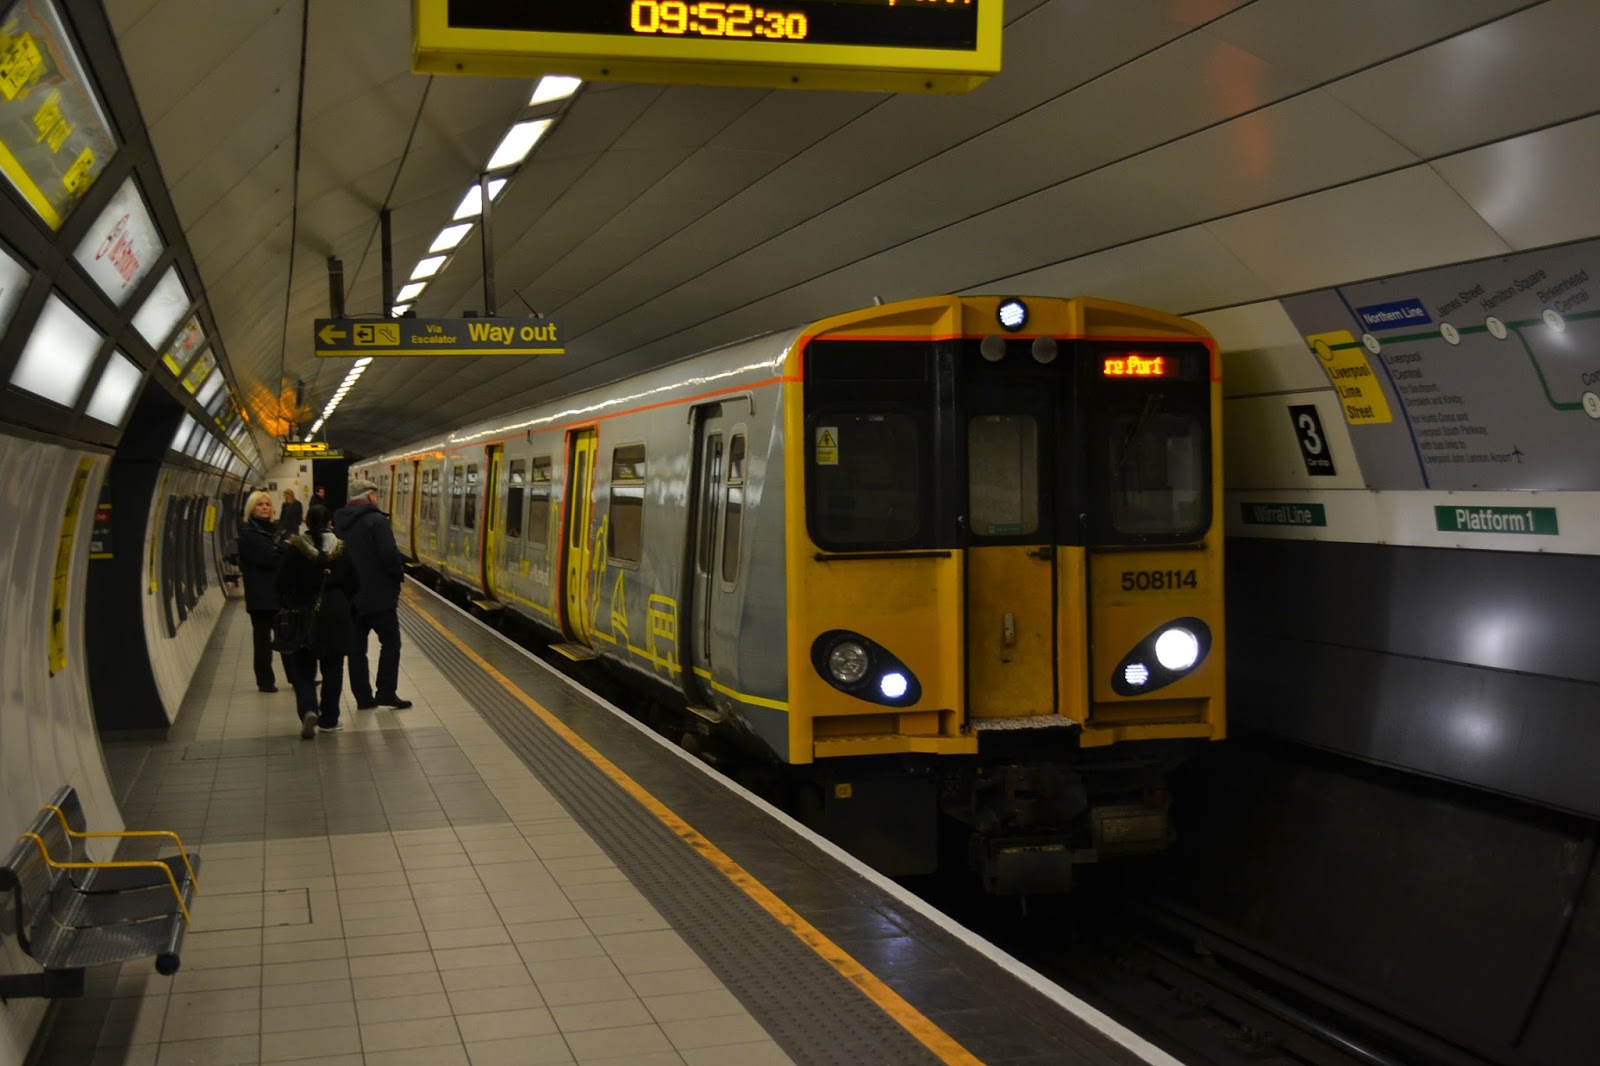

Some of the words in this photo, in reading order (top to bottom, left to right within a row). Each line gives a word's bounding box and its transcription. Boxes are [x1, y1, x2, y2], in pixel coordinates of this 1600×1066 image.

[631, 0, 807, 39] 09:52:30
[1480, 286, 1517, 311] Hamilton
[1513, 268, 1547, 292] Square
[1536, 269, 1589, 304] Birkenhead
[1436, 298, 1461, 318] James
[1458, 283, 1485, 303] Street
[1555, 288, 1590, 313] Central
[1362, 310, 1404, 325] Northern
[1402, 307, 1425, 319] Line
[426, 324, 443, 334] Via
[468, 322, 515, 345] Way
[520, 322, 558, 342] out
[411, 334, 457, 345] Escalator
[1385, 352, 1422, 366] Liverpool
[1328, 363, 1371, 380] Liverpool
[1392, 367, 1424, 380] Central
[1338, 385, 1363, 399] Lime
[1346, 404, 1375, 420] Street
[1298, 413, 1322, 455] 3
[1253, 505, 1288, 525] Wirral
[1287, 506, 1312, 525] Line
[1455, 508, 1524, 532] Platform
[1525, 511, 1535, 531] 1
[1121, 570, 1197, 591] 508114
